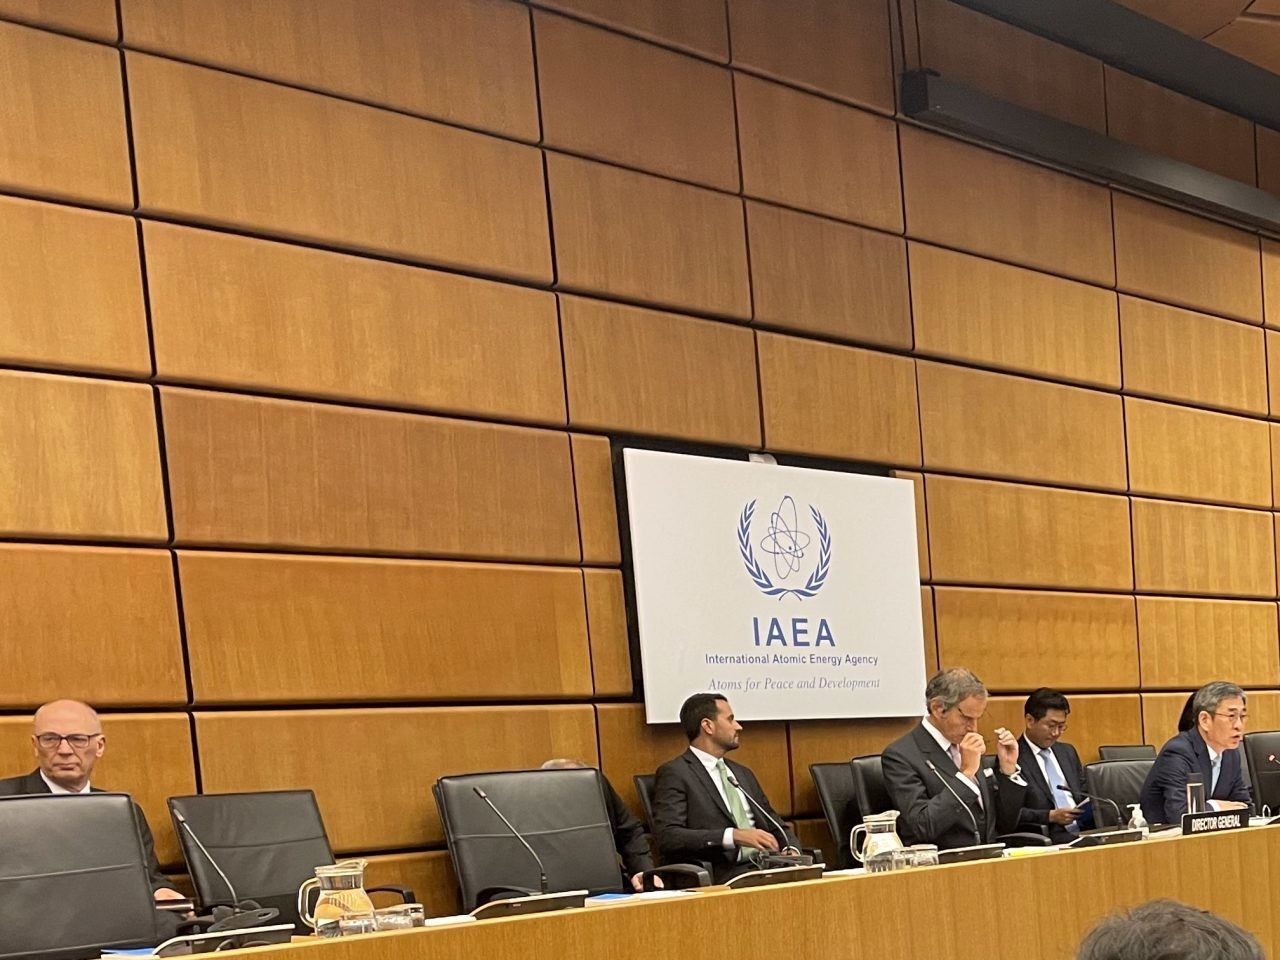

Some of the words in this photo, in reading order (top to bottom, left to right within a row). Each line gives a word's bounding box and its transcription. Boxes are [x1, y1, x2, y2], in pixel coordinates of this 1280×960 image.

[752, 616, 836, 647] IAEA
[705, 653, 770, 664] International
[772, 653, 807, 665] Atomic
[809, 653, 842, 667] Energy
[844, 653, 878, 667] Agency
[707, 677, 742, 691] Atoms
[743, 676, 761, 693] for
[764, 676, 794, 690] Peace
[796, 676, 816, 689] and
[818, 676, 880, 692] Development
[1192, 817, 1217, 831] DIRECTOR
[1218, 815, 1241, 828] GENERAL
